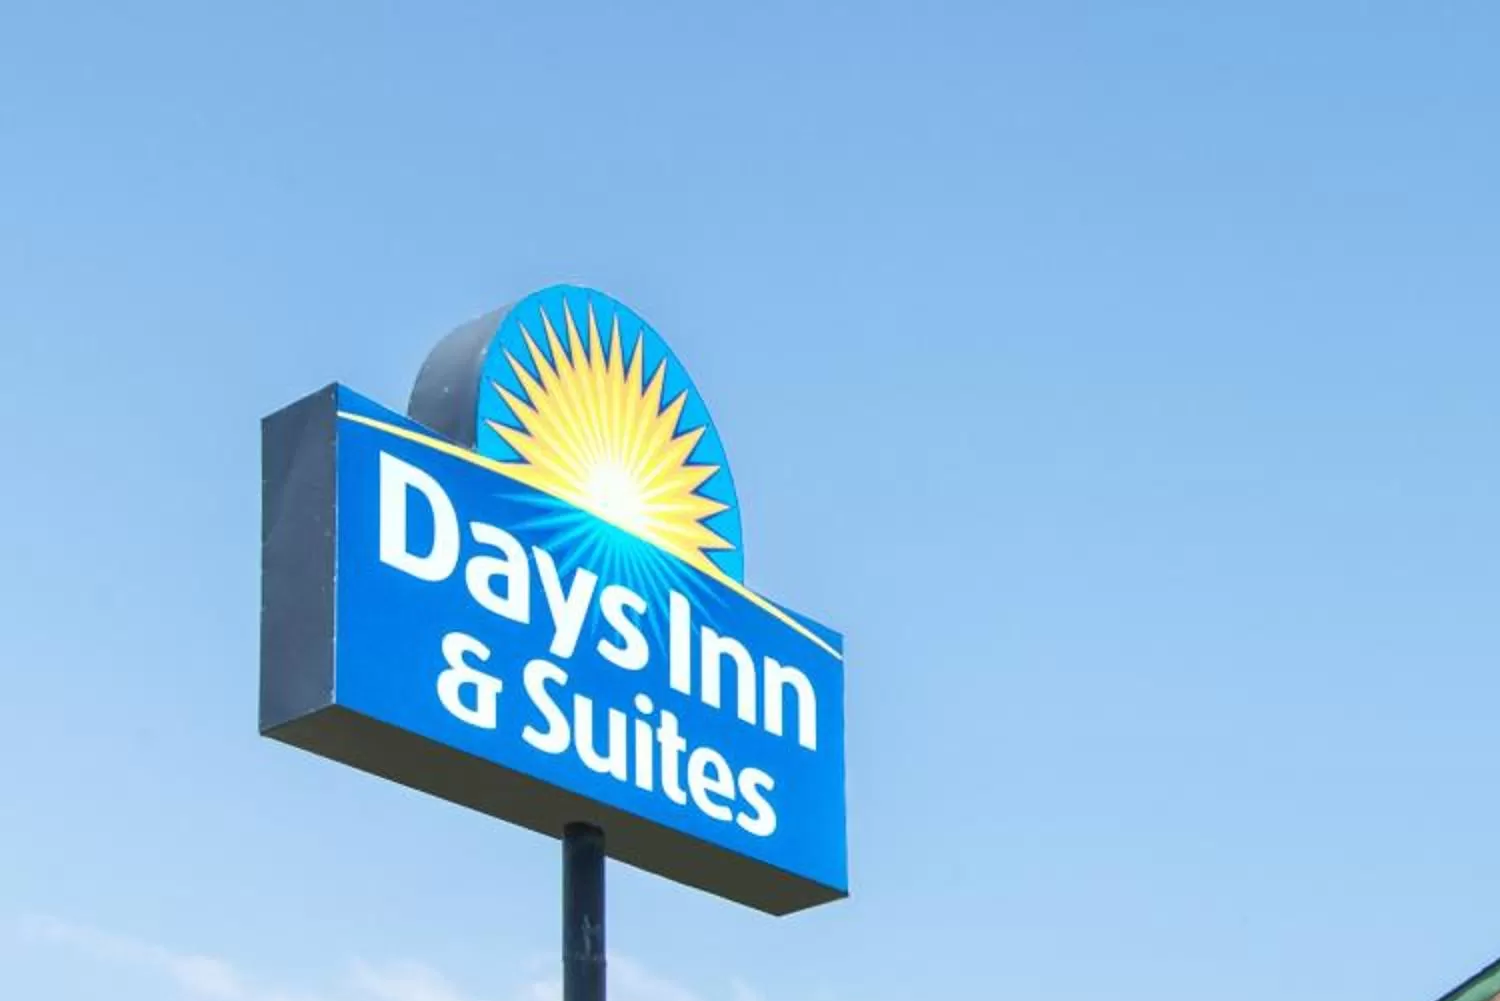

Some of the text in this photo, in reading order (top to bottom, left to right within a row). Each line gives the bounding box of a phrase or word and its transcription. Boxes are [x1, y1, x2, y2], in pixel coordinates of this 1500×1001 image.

[379, 451, 817, 750] Days Inn
[436, 631, 777, 837] & Suites
